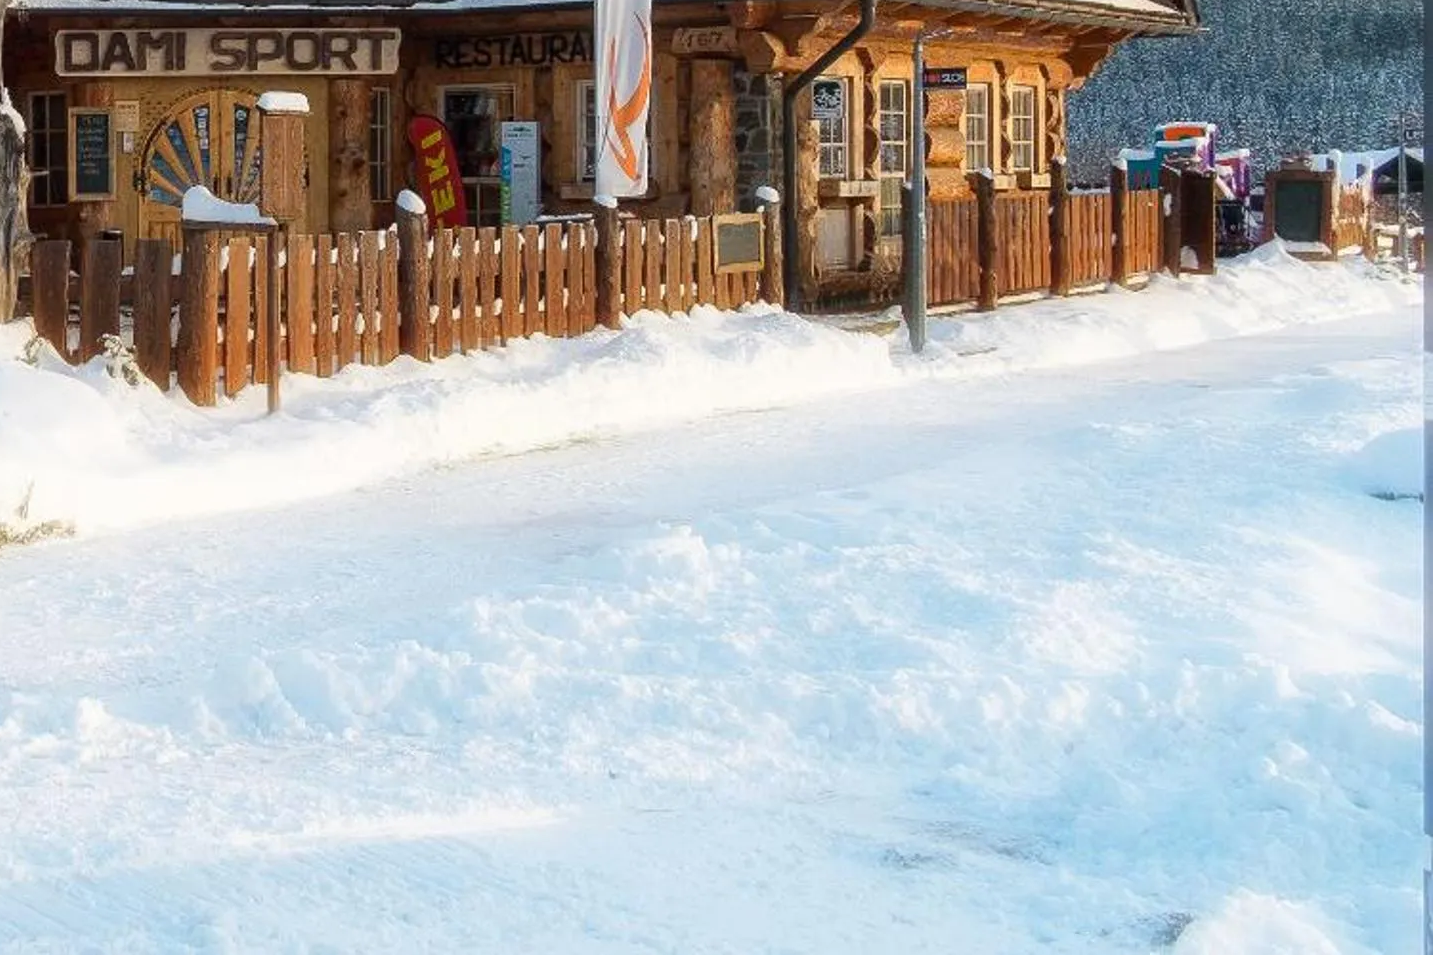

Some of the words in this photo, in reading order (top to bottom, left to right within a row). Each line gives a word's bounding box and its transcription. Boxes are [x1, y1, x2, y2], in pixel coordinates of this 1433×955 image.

[64, 31, 187, 72] DAMI
[209, 30, 397, 72] SPORT
[434, 29, 595, 70] RESTAURA
